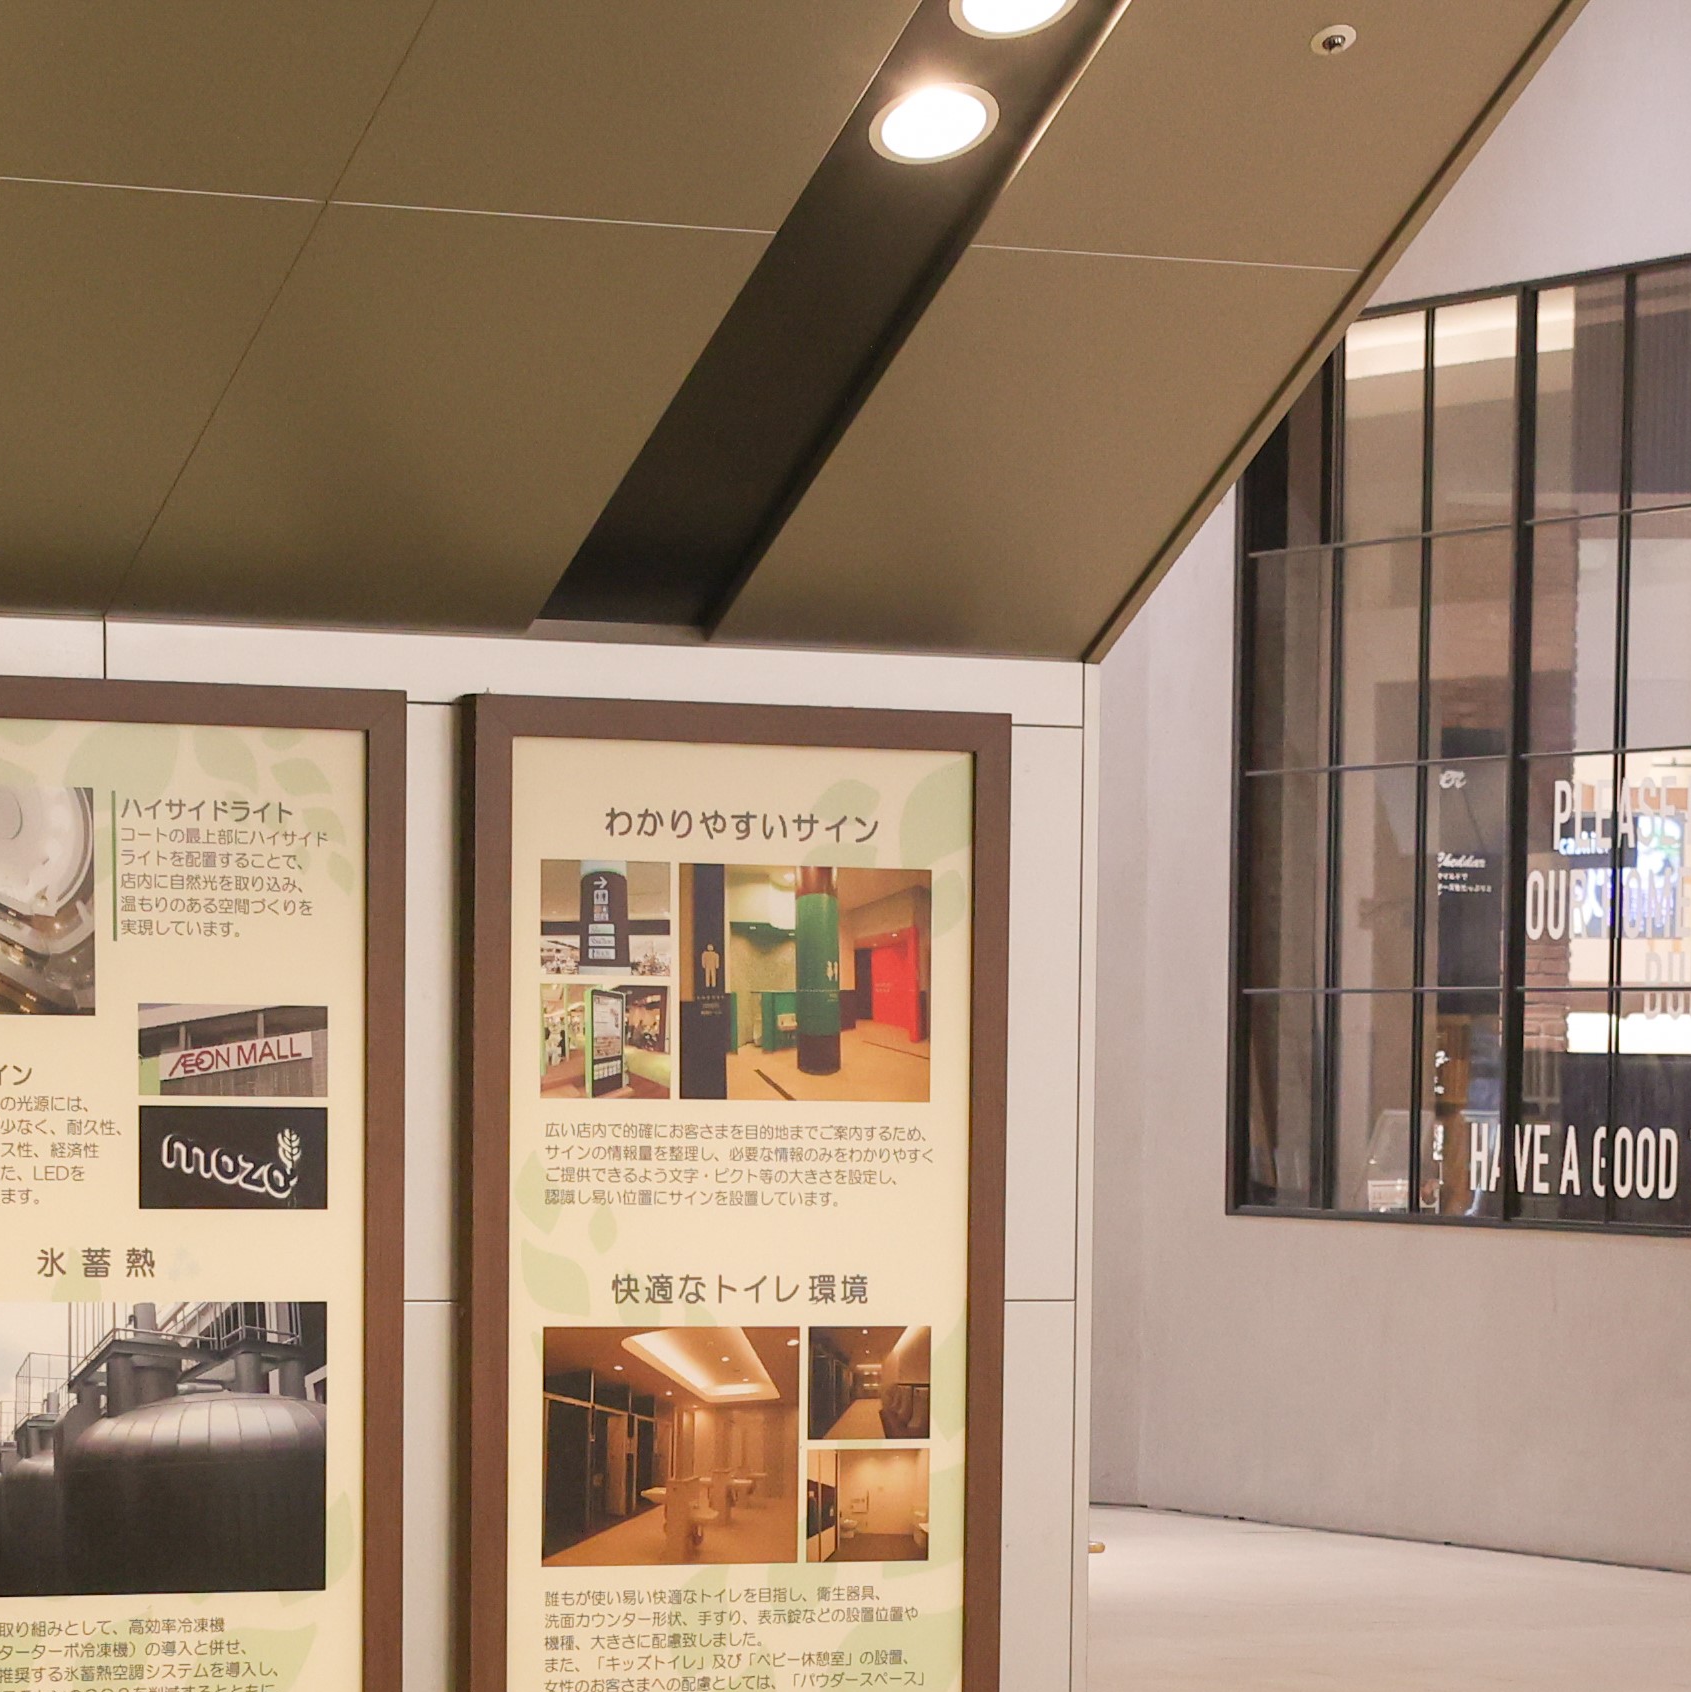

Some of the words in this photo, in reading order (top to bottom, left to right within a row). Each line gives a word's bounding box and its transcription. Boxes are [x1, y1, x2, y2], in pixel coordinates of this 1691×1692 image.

[120, 798, 293, 824] ハイサイドライト
[120, 826, 329, 848] コートの最上部にハイサイド
[604, 807, 881, 845] わかりやすいサイン
[120, 849, 304, 870] ライトを配置することで、
[120, 873, 304, 894] 店内に自然光を取り込み、
[120, 895, 314, 917] 温もりのある空間づくりを
[1525, 866, 1588, 941] OUR
[120, 918, 240, 938] 実現しています。
[237, 1037, 302, 1067] MALL
[161, 1133, 298, 1200] mozo
[1559, 1125, 1581, 1196] A
[1593, 1126, 1680, 1200] GOOD
[543, 1188, 841, 1208] 認識し易い位置にサインを設置しています。
[36, 1247, 156, 1280] 氷蓄熱
[611, 1273, 869, 1305] 快適なトイレ環境
